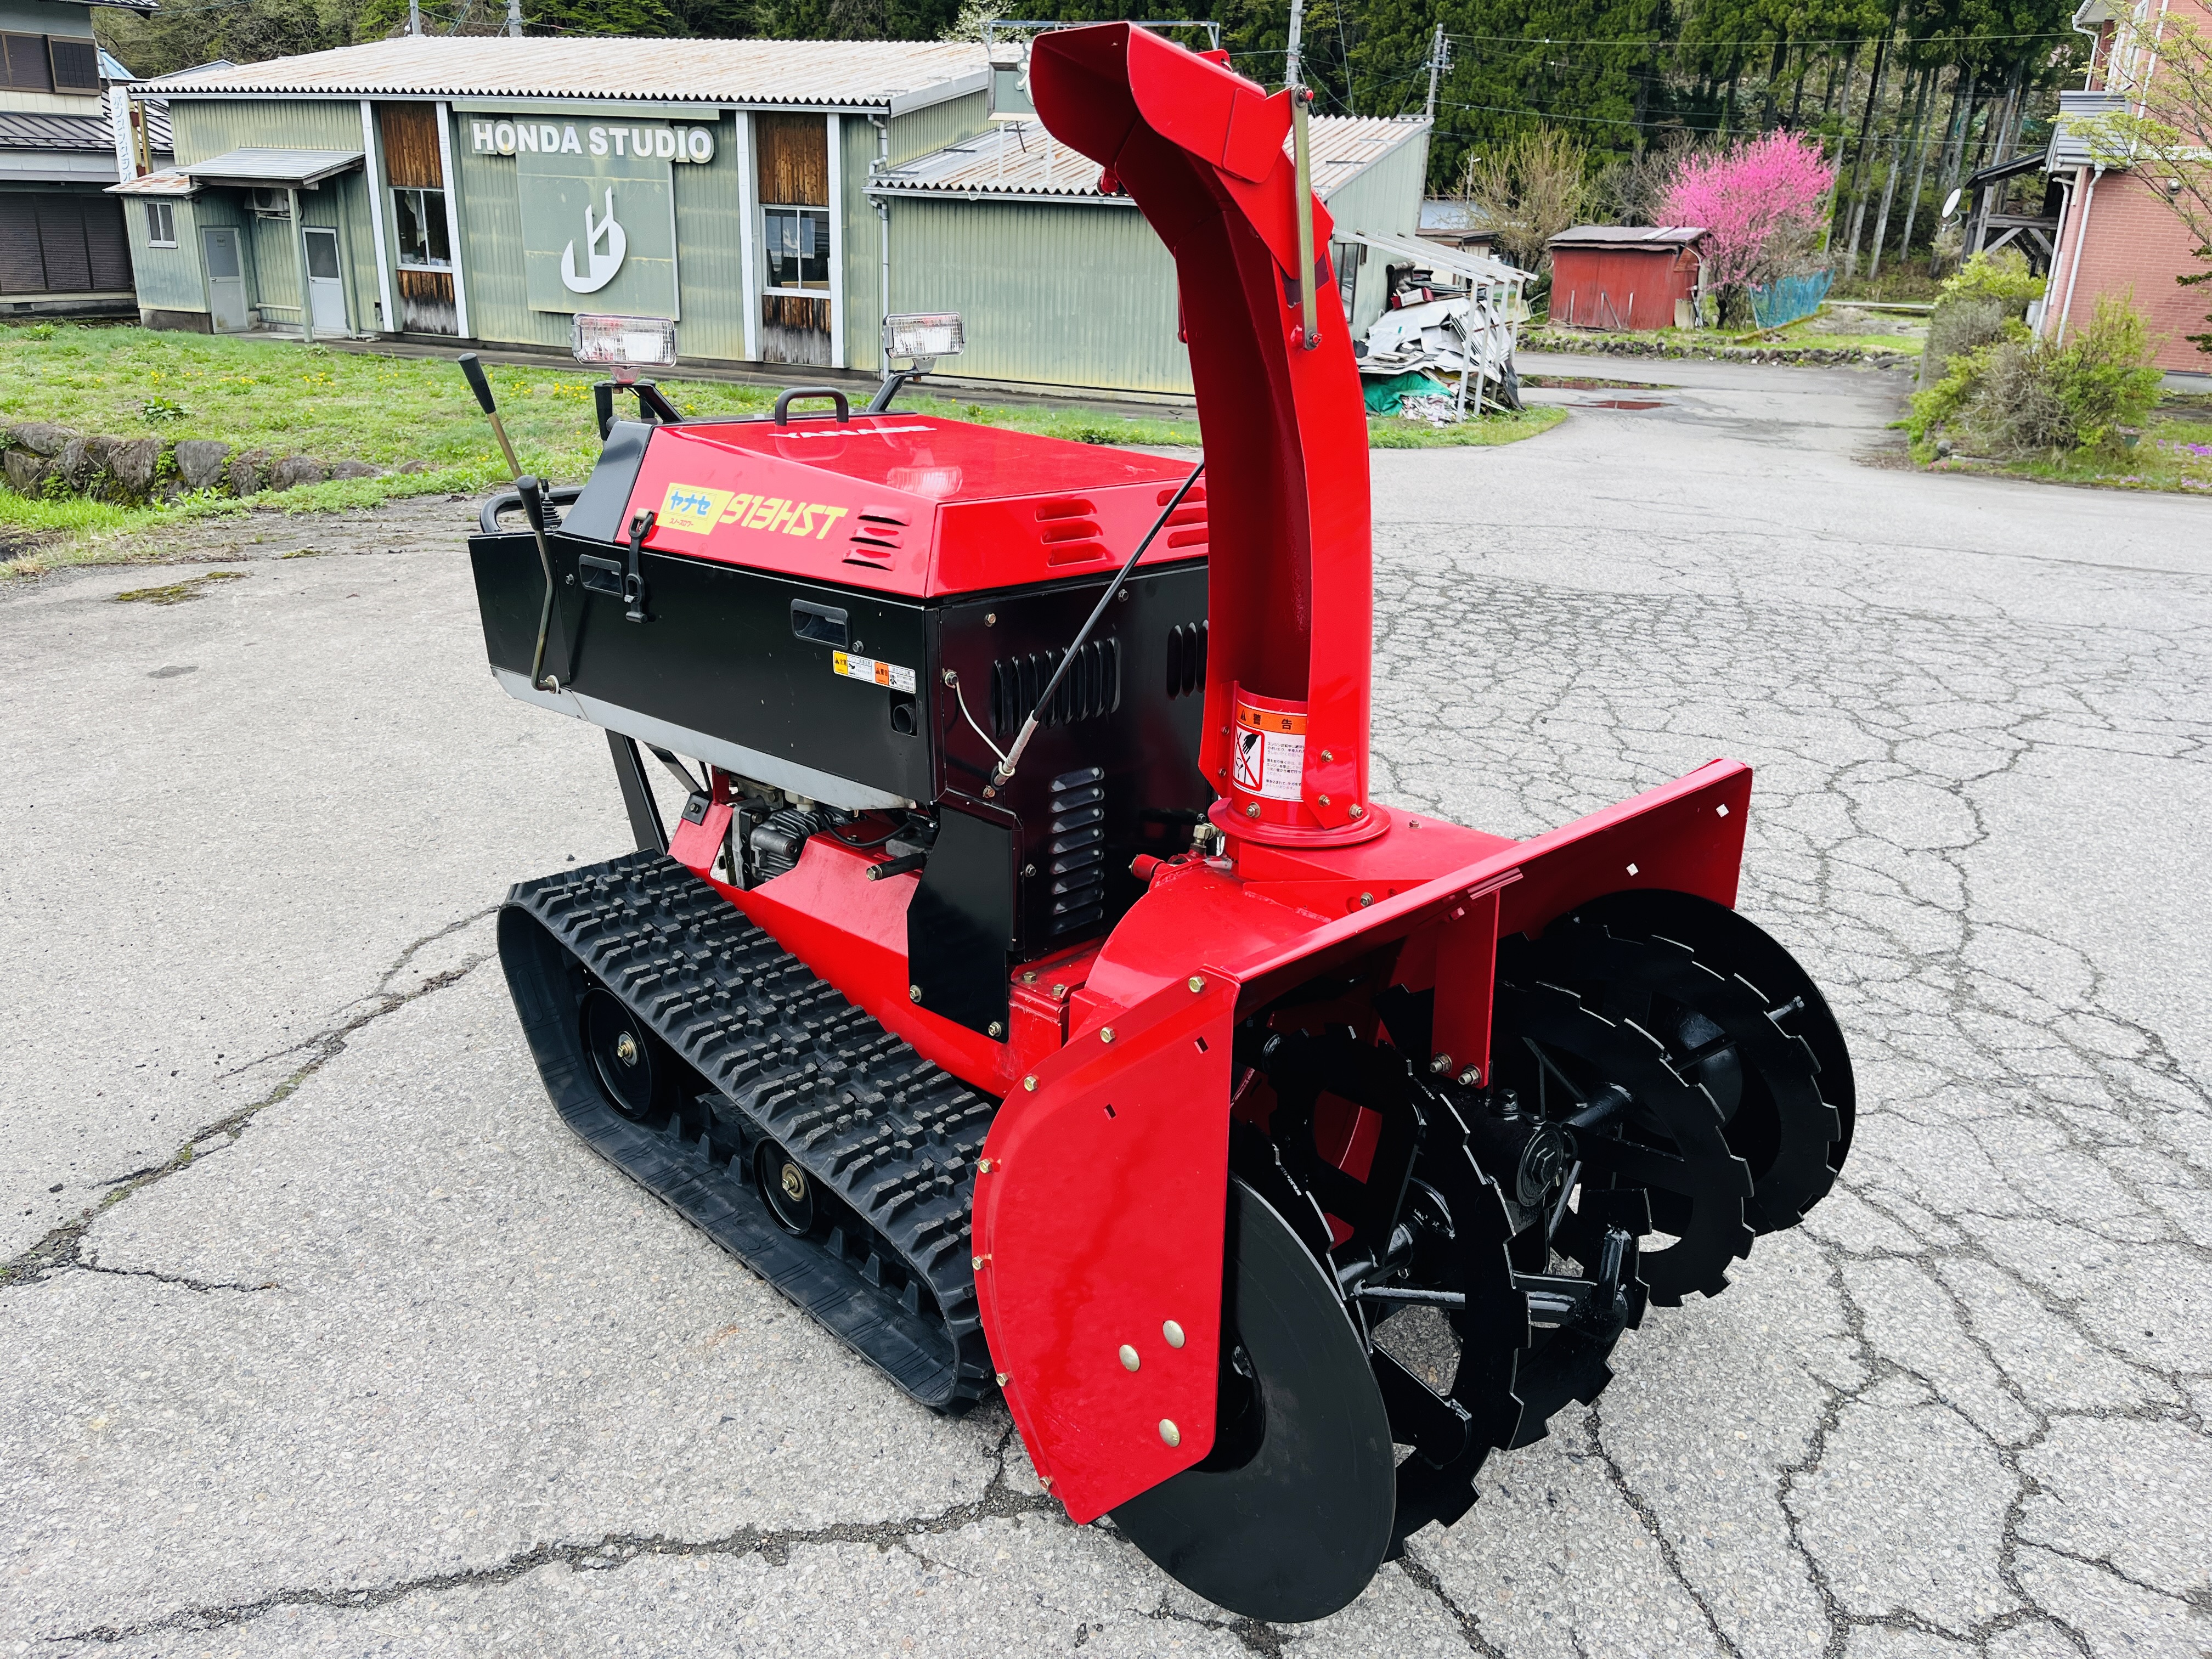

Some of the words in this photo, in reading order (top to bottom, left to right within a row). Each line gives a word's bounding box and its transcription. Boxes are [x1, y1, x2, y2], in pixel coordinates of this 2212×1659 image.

[472, 123, 583, 154] HONDA
[589, 126, 712, 159] STUDIO
[670, 491, 711, 516] ヤナセ
[719, 493, 849, 539] 913HST
